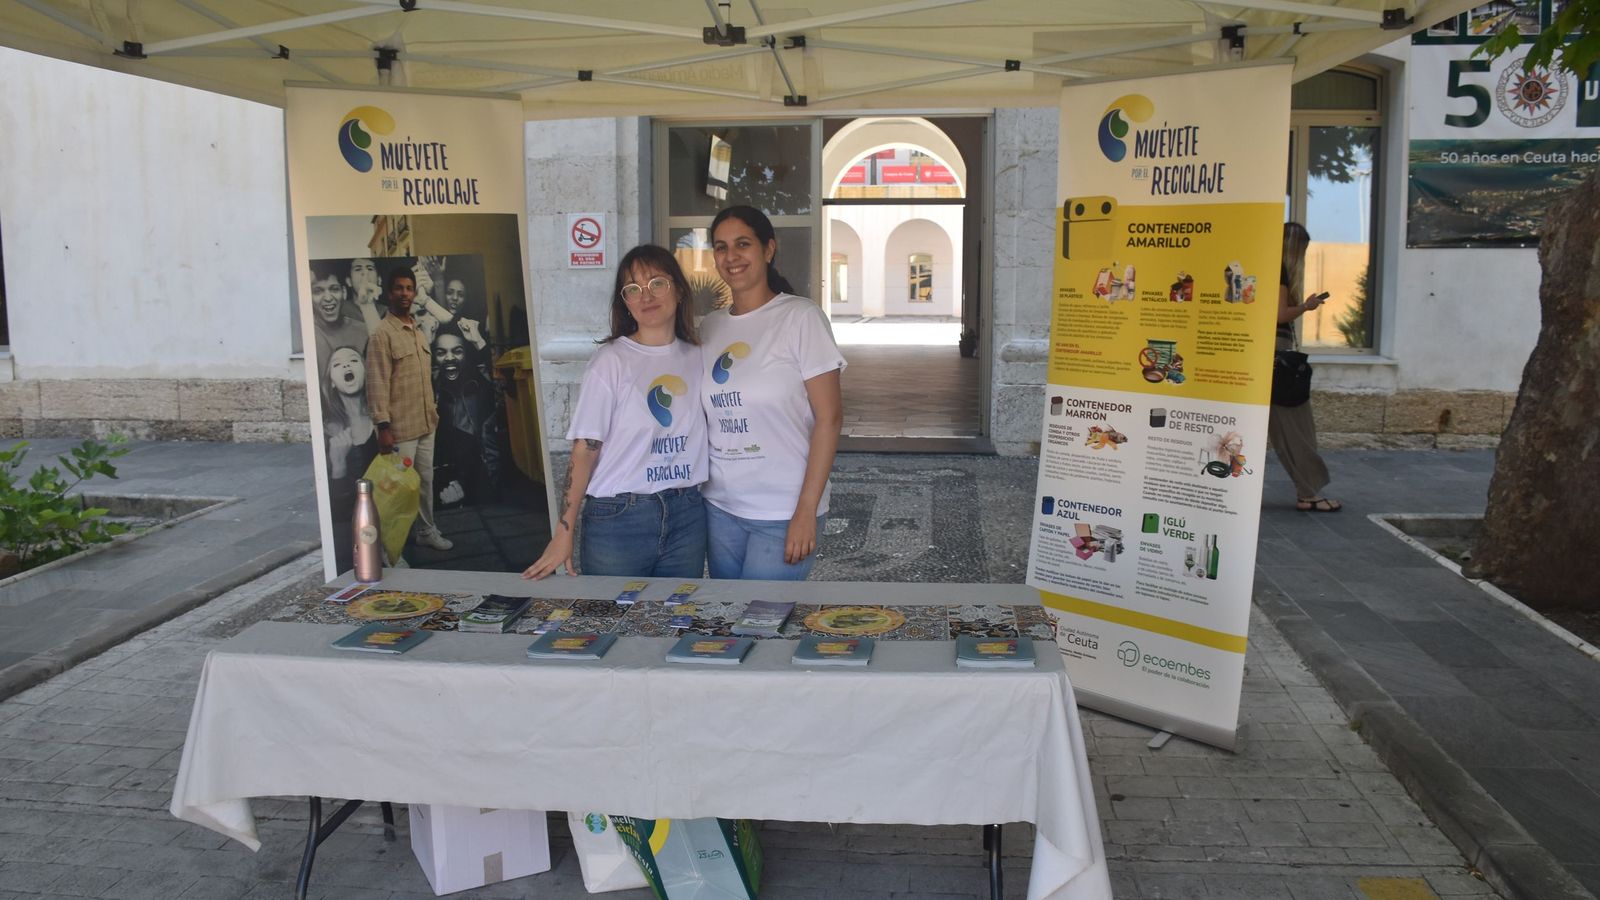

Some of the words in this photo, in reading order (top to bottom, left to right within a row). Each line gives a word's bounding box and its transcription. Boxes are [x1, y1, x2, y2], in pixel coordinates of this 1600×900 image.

[1134, 122, 1200, 159] MUÉVETE
[380, 136, 449, 171] MUÉVETE
[1440, 152, 1459, 164] 50
[1462, 152, 1497, 164] años
[1502, 155, 1519, 164] en
[1523, 151, 1566, 164] Ceuta
[381, 179, 392, 190] POR
[1151, 162, 1226, 195] RECICLAJE
[402, 178, 480, 206] RECICLAJE
[1128, 222, 1212, 234] CONTENEDOR
[1126, 236, 1191, 248] AMARILLO
[710, 390, 742, 408] MUÉVETE
[1066, 398, 1132, 413] CONTENEDOR
[1065, 408, 1107, 421] MARRÓN
[1170, 410, 1236, 426] CONTENEDOR
[1169, 420, 1182, 430] DE
[1184, 422, 1214, 434] RESTO
[650, 434, 689, 456] MUÉVETE
[1056, 509, 1080, 521] AZUL
[1058, 498, 1122, 517] CONTENEDOR
[1164, 516, 1186, 528] IGLÚ
[1163, 527, 1196, 542] VERDE
[1067, 633, 1098, 650] Ceuta
[1143, 653, 1212, 680] ecoembes
[1148, 667, 1163, 677] poder
[1164, 670, 1170, 678] de
